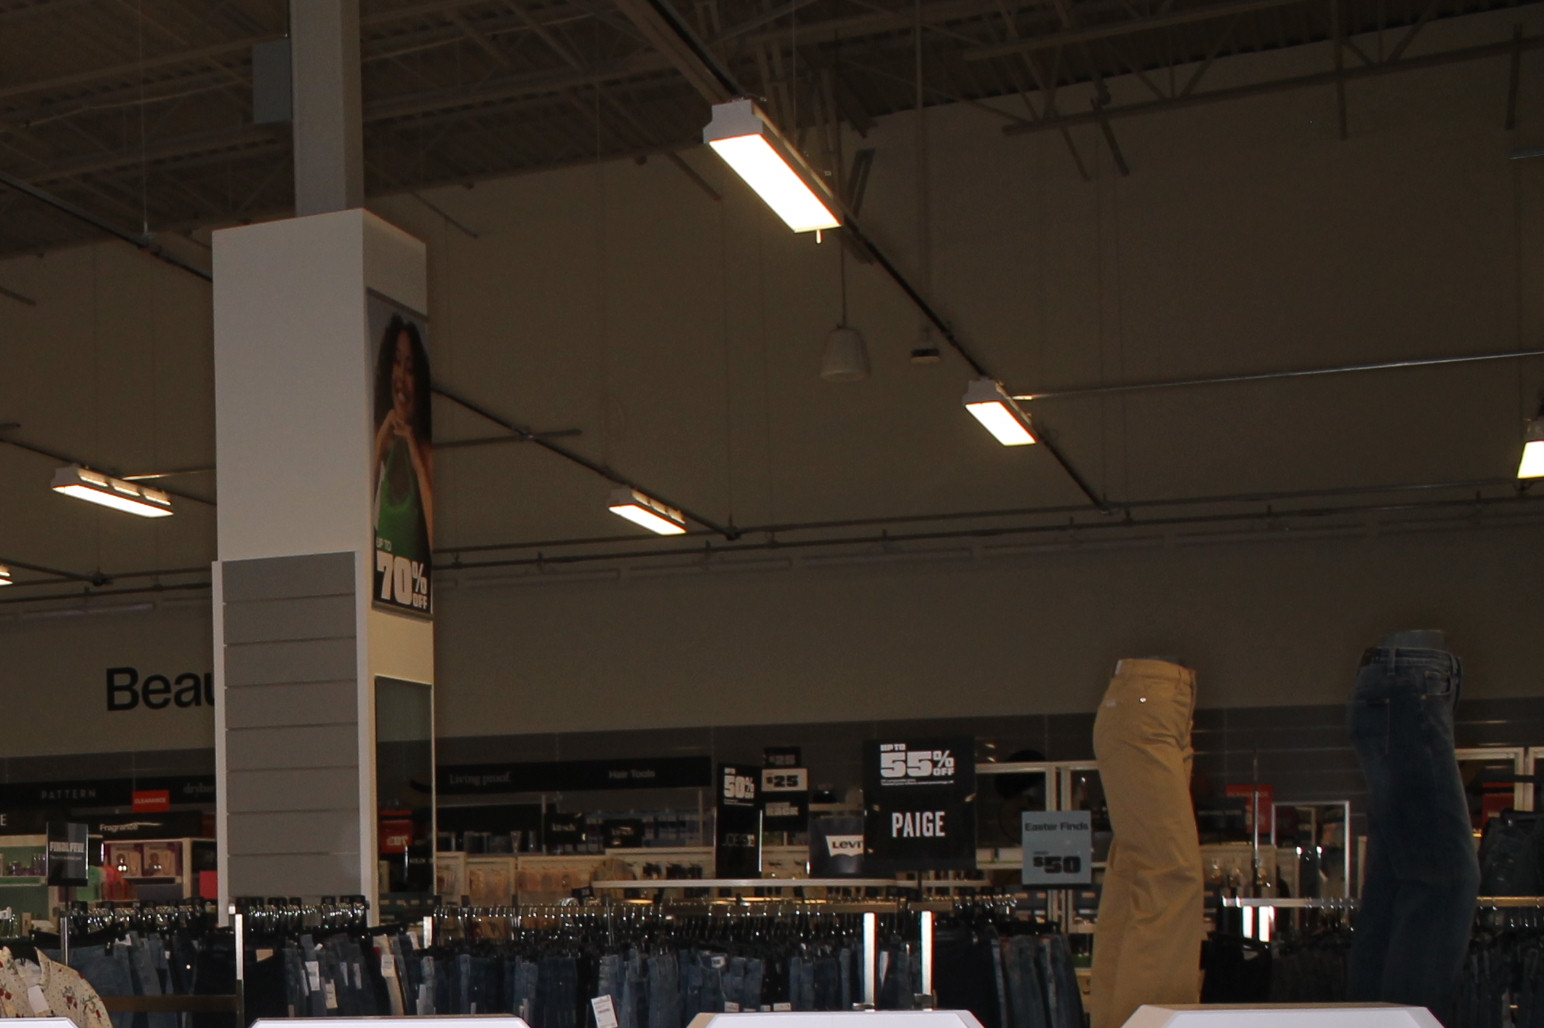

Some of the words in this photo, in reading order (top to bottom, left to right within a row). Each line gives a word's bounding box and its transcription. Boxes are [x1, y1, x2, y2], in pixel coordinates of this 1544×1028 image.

[376, 549, 428, 606] 70%
[880, 749, 955, 778] 55%
[932, 767, 955, 776] OFF
[40, 788, 97, 801] PATTERN
[891, 811, 946, 838] PAIGE
[1024, 822, 1058, 832] Easter
[1060, 821, 1089, 831] Finds
[1033, 856, 1081, 874] $50
